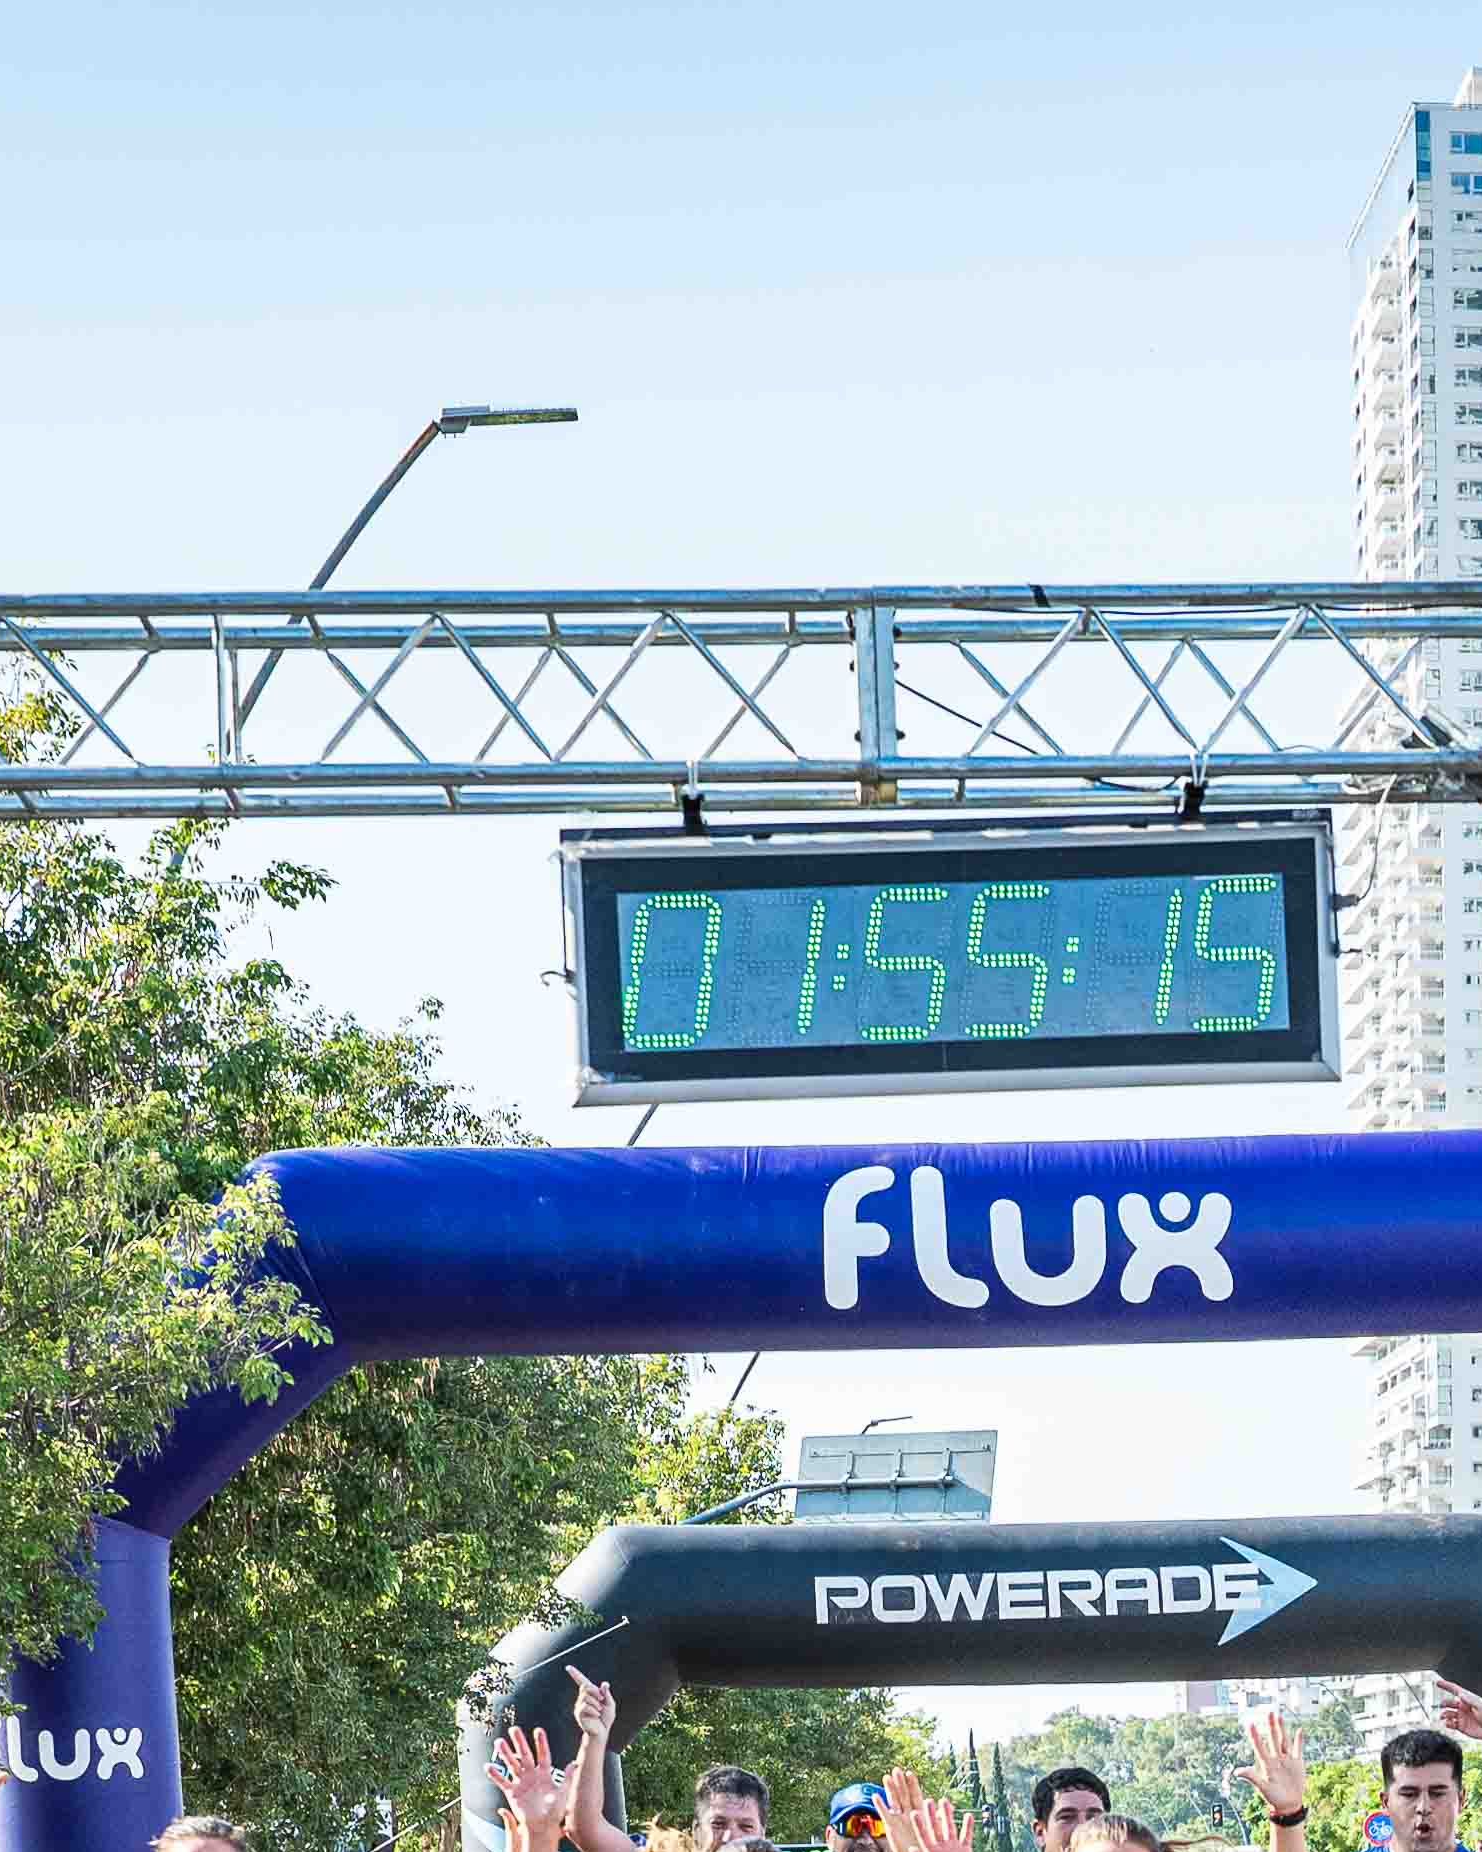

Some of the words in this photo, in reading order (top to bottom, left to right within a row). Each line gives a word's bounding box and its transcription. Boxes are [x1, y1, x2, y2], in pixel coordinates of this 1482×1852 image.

[621, 874, 1277, 1051] 01:55:15
[813, 1563, 1264, 1626] POWERADE
[6, 1714, 145, 1784] lux
